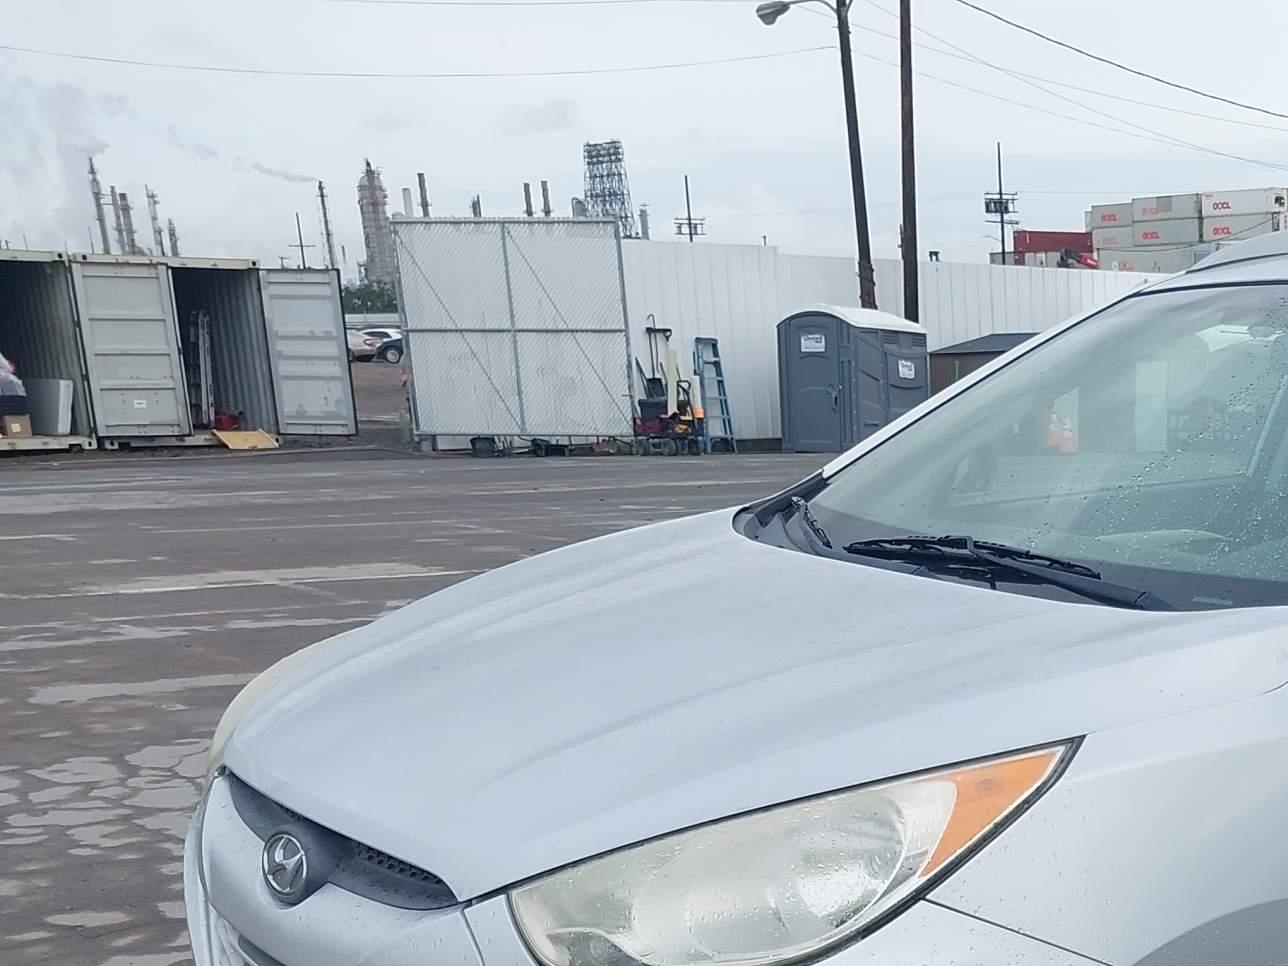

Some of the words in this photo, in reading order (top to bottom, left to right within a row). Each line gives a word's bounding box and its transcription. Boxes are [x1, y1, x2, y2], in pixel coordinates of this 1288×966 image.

[1213, 201, 1231, 210] OOCL
[1101, 213, 1117, 222] OOCL
[1142, 231, 1160, 240] OOCL
[1212, 227, 1231, 236] OOCL
